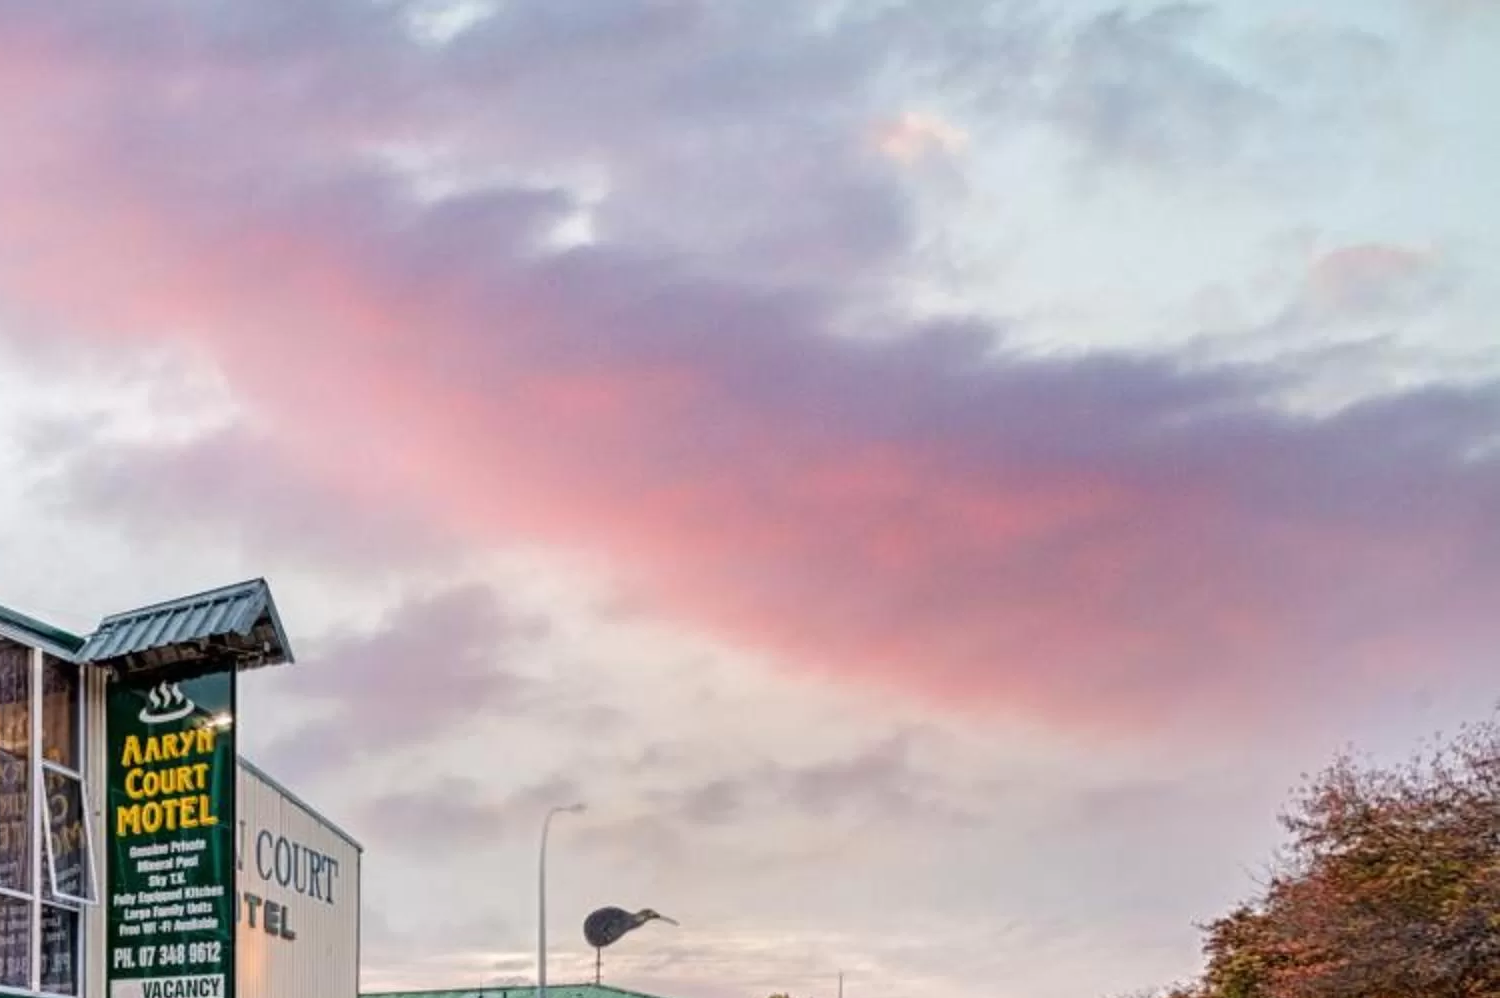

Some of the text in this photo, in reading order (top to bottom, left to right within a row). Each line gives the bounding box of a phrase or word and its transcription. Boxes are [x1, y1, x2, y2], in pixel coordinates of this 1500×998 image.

[124, 762, 210, 799] COURT
[116, 794, 219, 837] MOTEL
[257, 829, 339, 905] COURT
[138, 945, 156, 967] 07
[159, 943, 186, 965] 348
[189, 941, 222, 964] 9612
